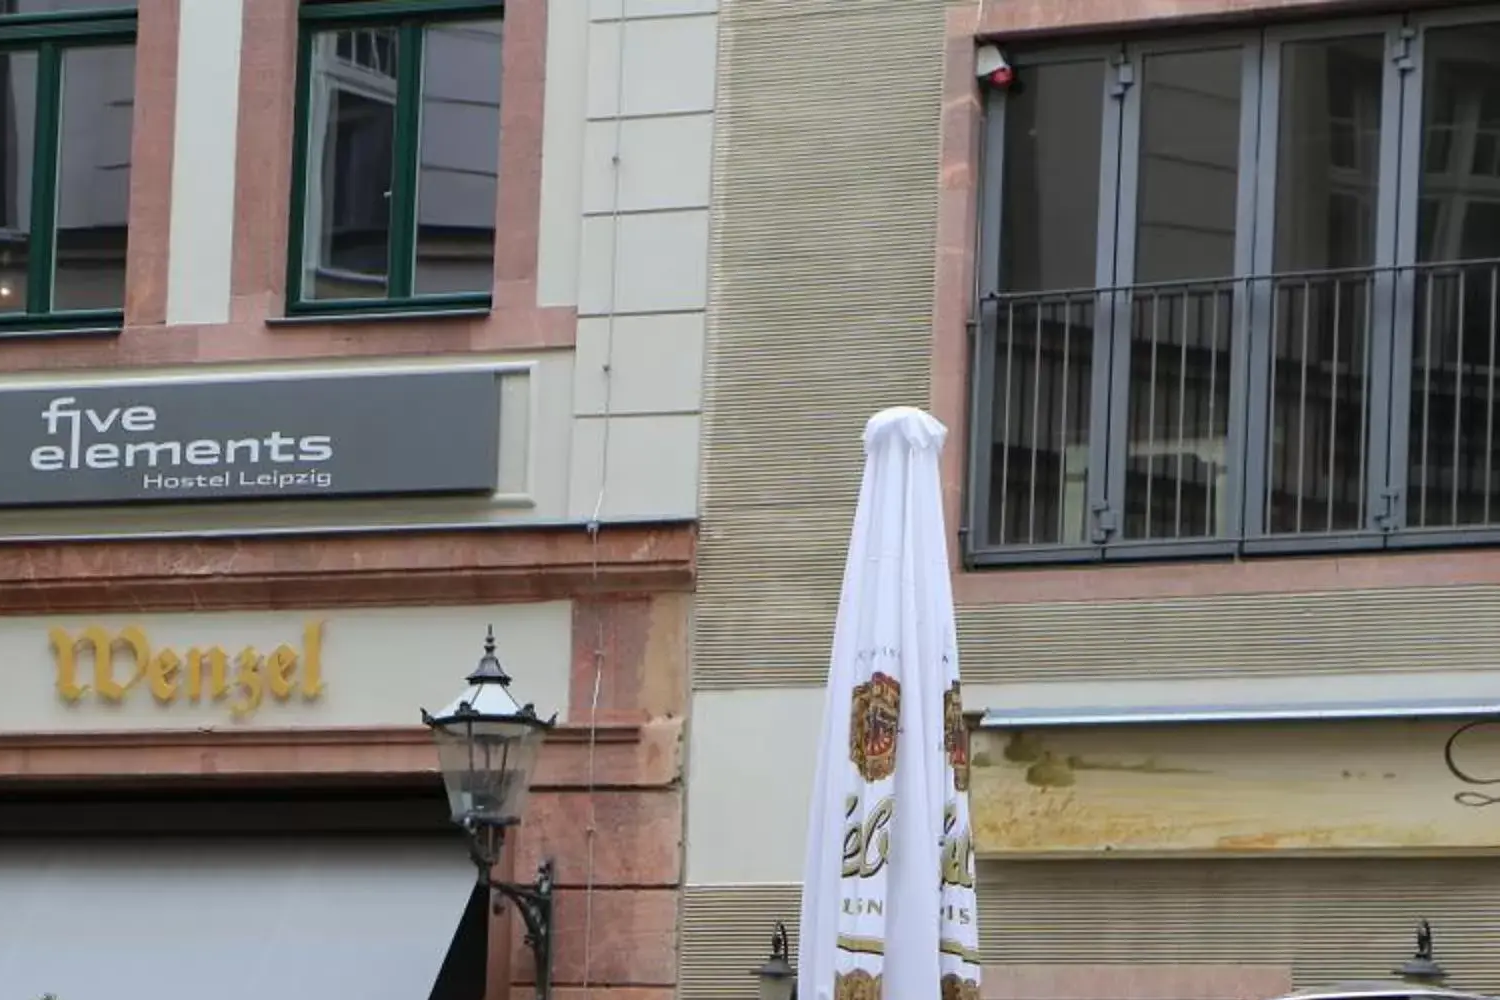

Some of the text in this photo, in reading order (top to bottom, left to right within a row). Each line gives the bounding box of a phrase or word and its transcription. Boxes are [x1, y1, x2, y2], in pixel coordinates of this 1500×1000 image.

[41, 396, 157, 434] five
[30, 430, 333, 470] elements
[143, 469, 332, 490] Hostel Leipzig
